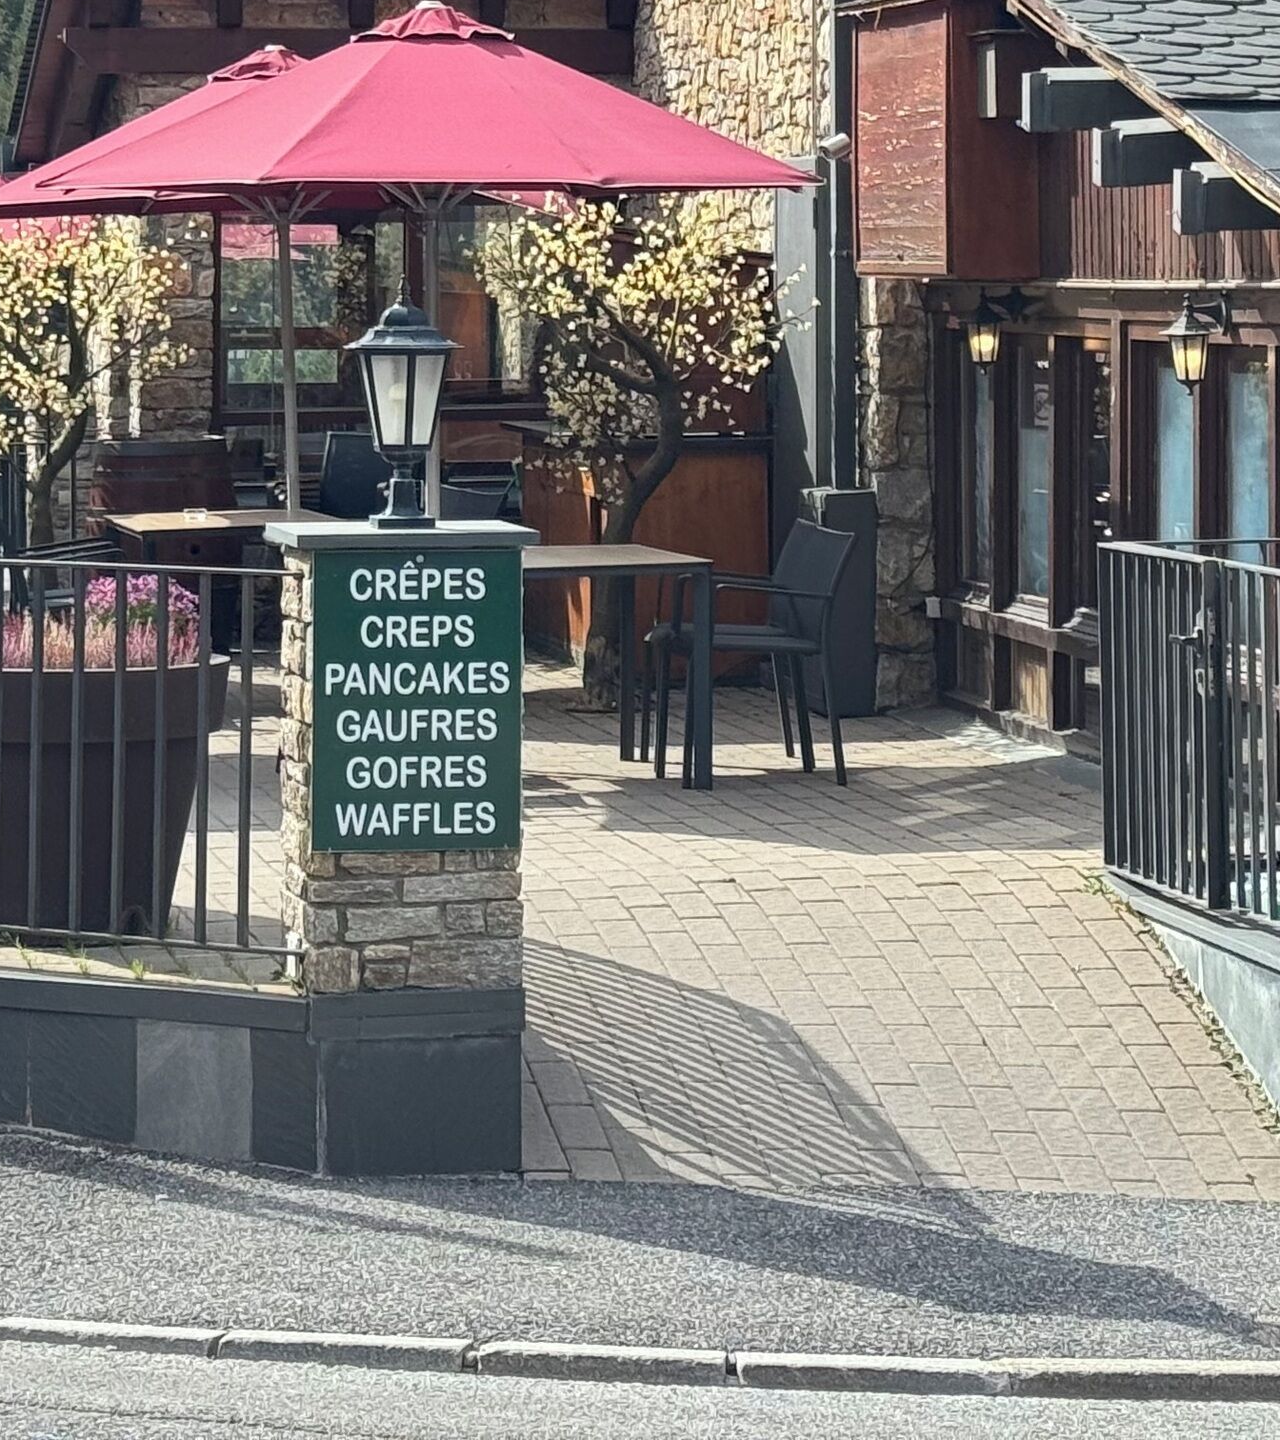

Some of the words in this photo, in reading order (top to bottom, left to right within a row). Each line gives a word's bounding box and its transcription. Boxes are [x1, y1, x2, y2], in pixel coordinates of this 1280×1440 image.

[349, 560, 487, 602] CRÊPES
[360, 614, 476, 649] CREPS
[324, 661, 511, 697] PANCAKES
[336, 708, 499, 743] GAUFRES
[346, 754, 488, 790] GOFRES
[335, 801, 497, 837] WAFFLES
